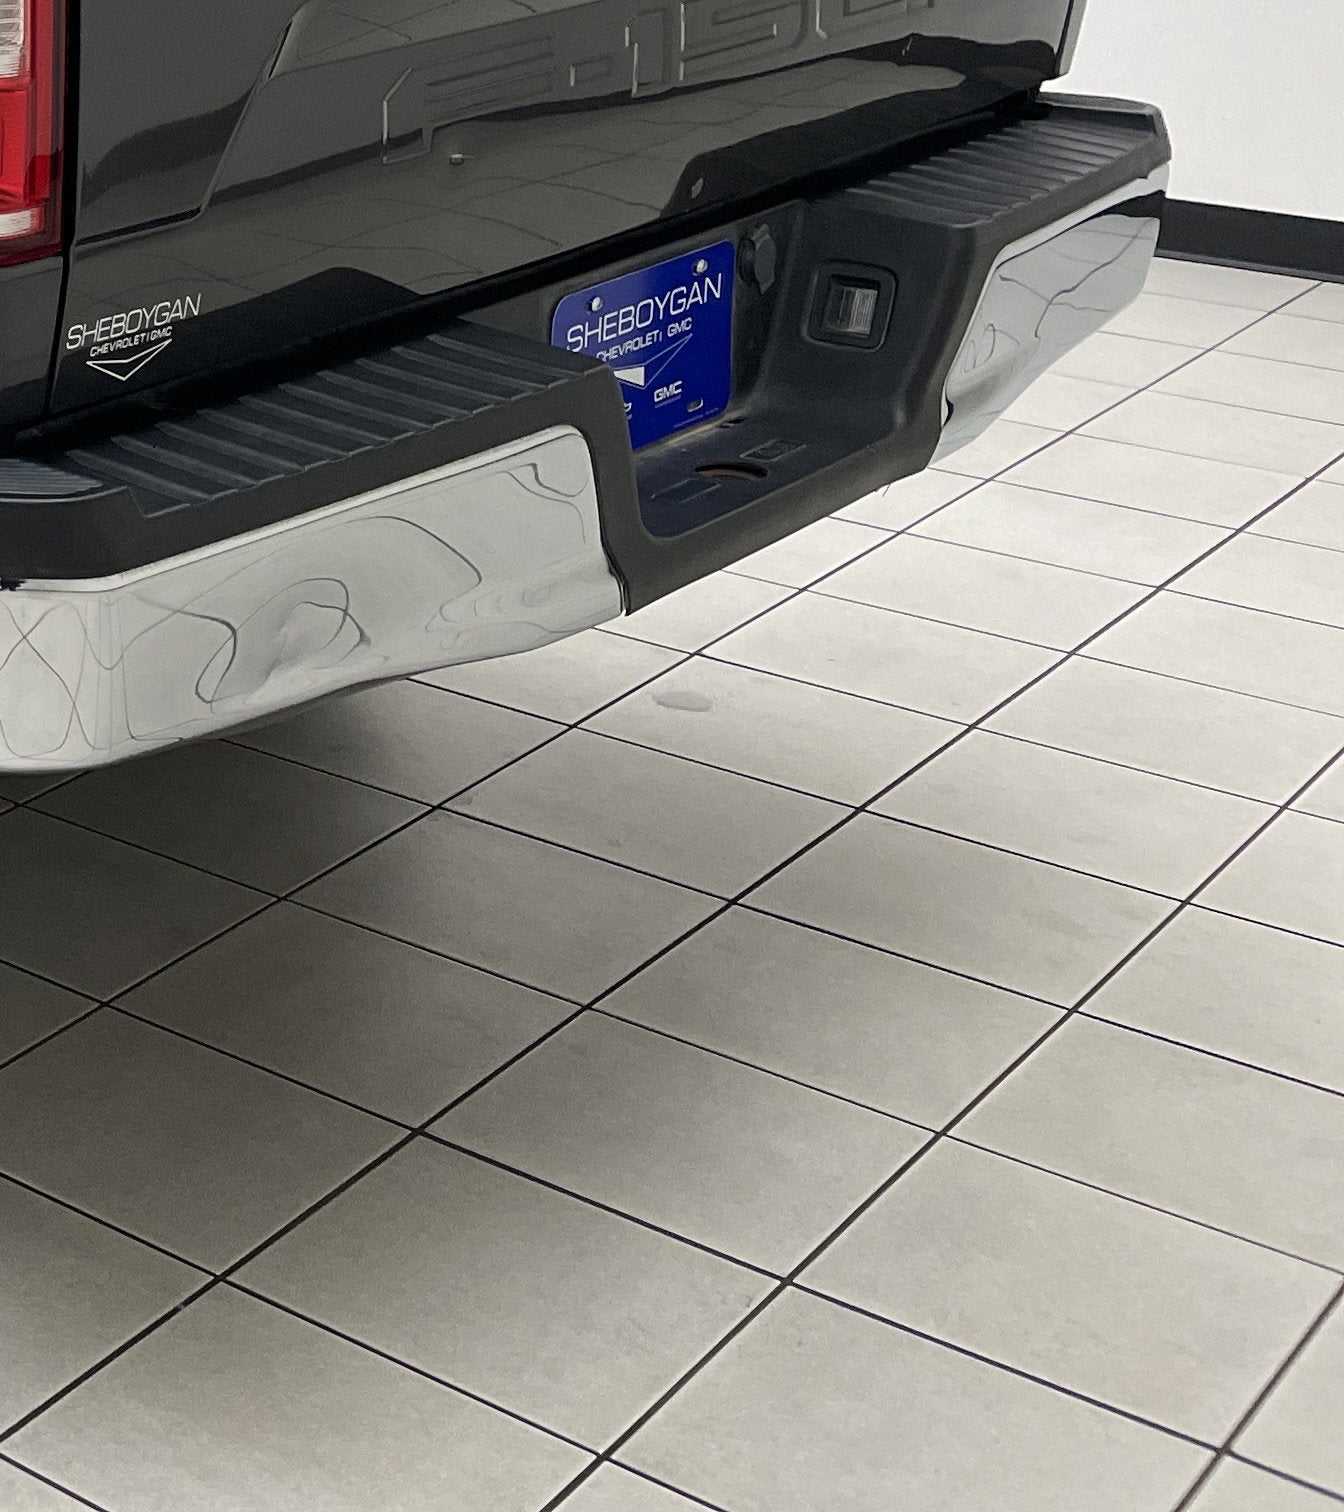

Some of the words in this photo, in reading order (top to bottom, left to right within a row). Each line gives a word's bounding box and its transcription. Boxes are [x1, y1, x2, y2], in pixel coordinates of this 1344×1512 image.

[65, 292, 202, 350] SHEBOYGAN
[566, 273, 722, 353] SHEBOYGAN
[667, 317, 693, 338] GMC
[89, 333, 147, 357] CHEVROLET
[654, 380, 683, 402] GMC
